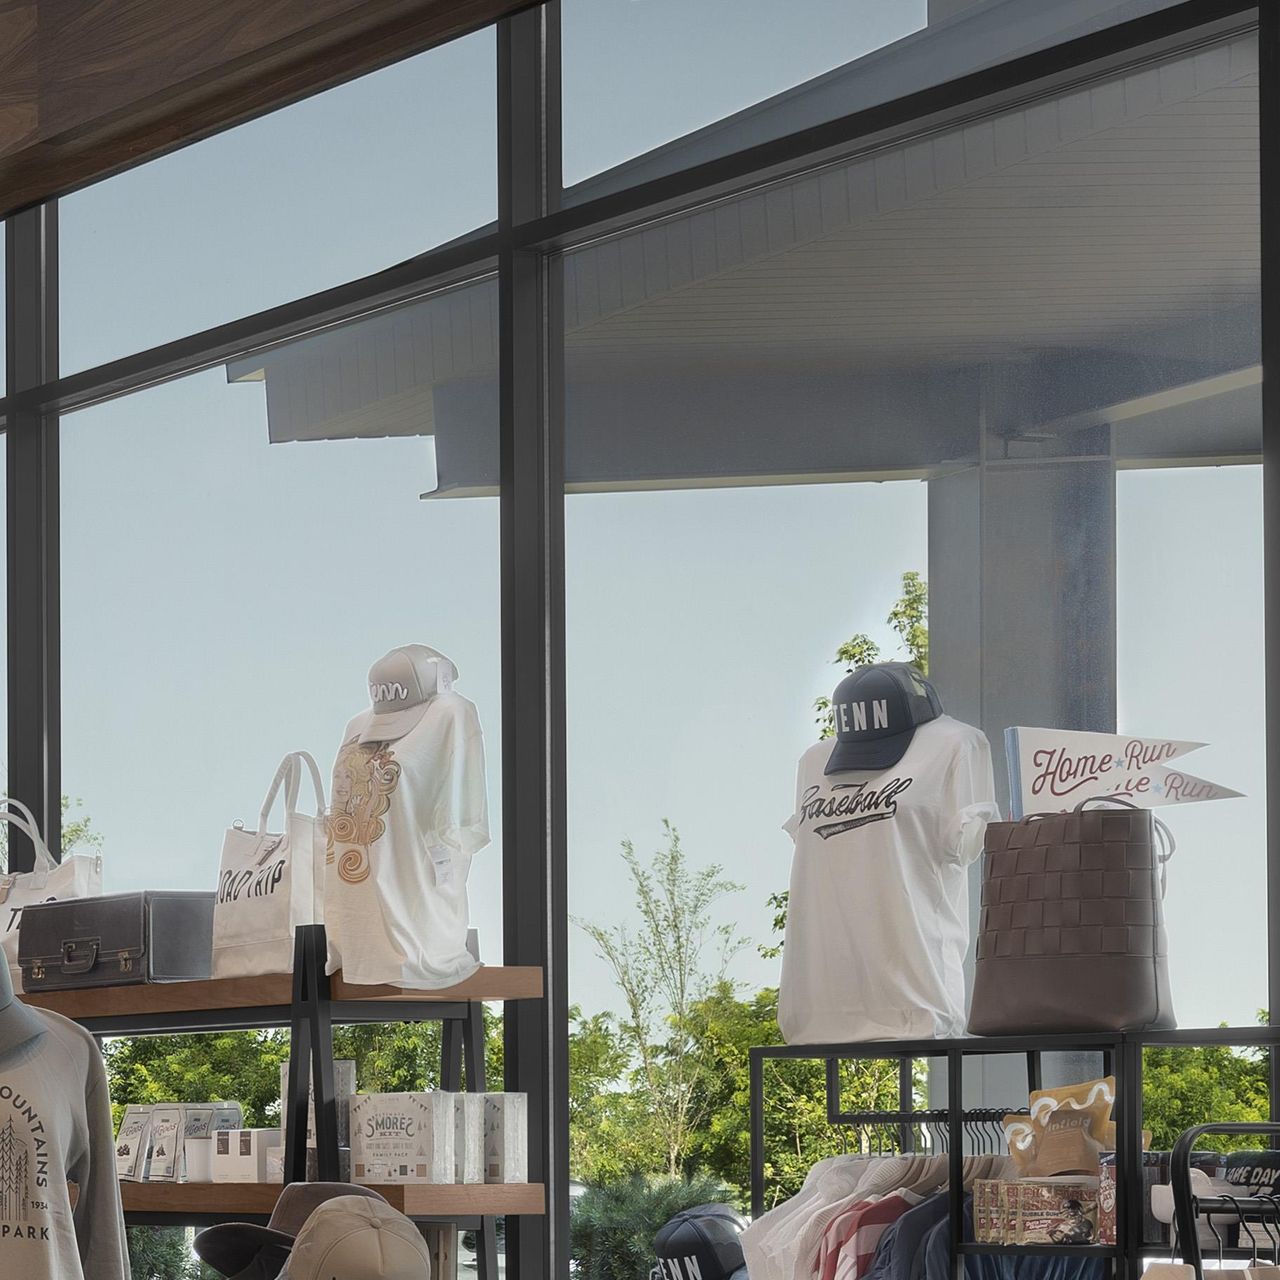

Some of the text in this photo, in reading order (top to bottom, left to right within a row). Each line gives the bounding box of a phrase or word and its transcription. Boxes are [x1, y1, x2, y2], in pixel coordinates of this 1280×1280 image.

[1032, 747, 1113, 798] Home
[1124, 739, 1178, 771] Run
[1164, 772, 1219, 800] Run
[247, 859, 286, 898] TRIP
[365, 1116, 415, 1138] S'MORES
[1, 1225, 50, 1240] PARK
